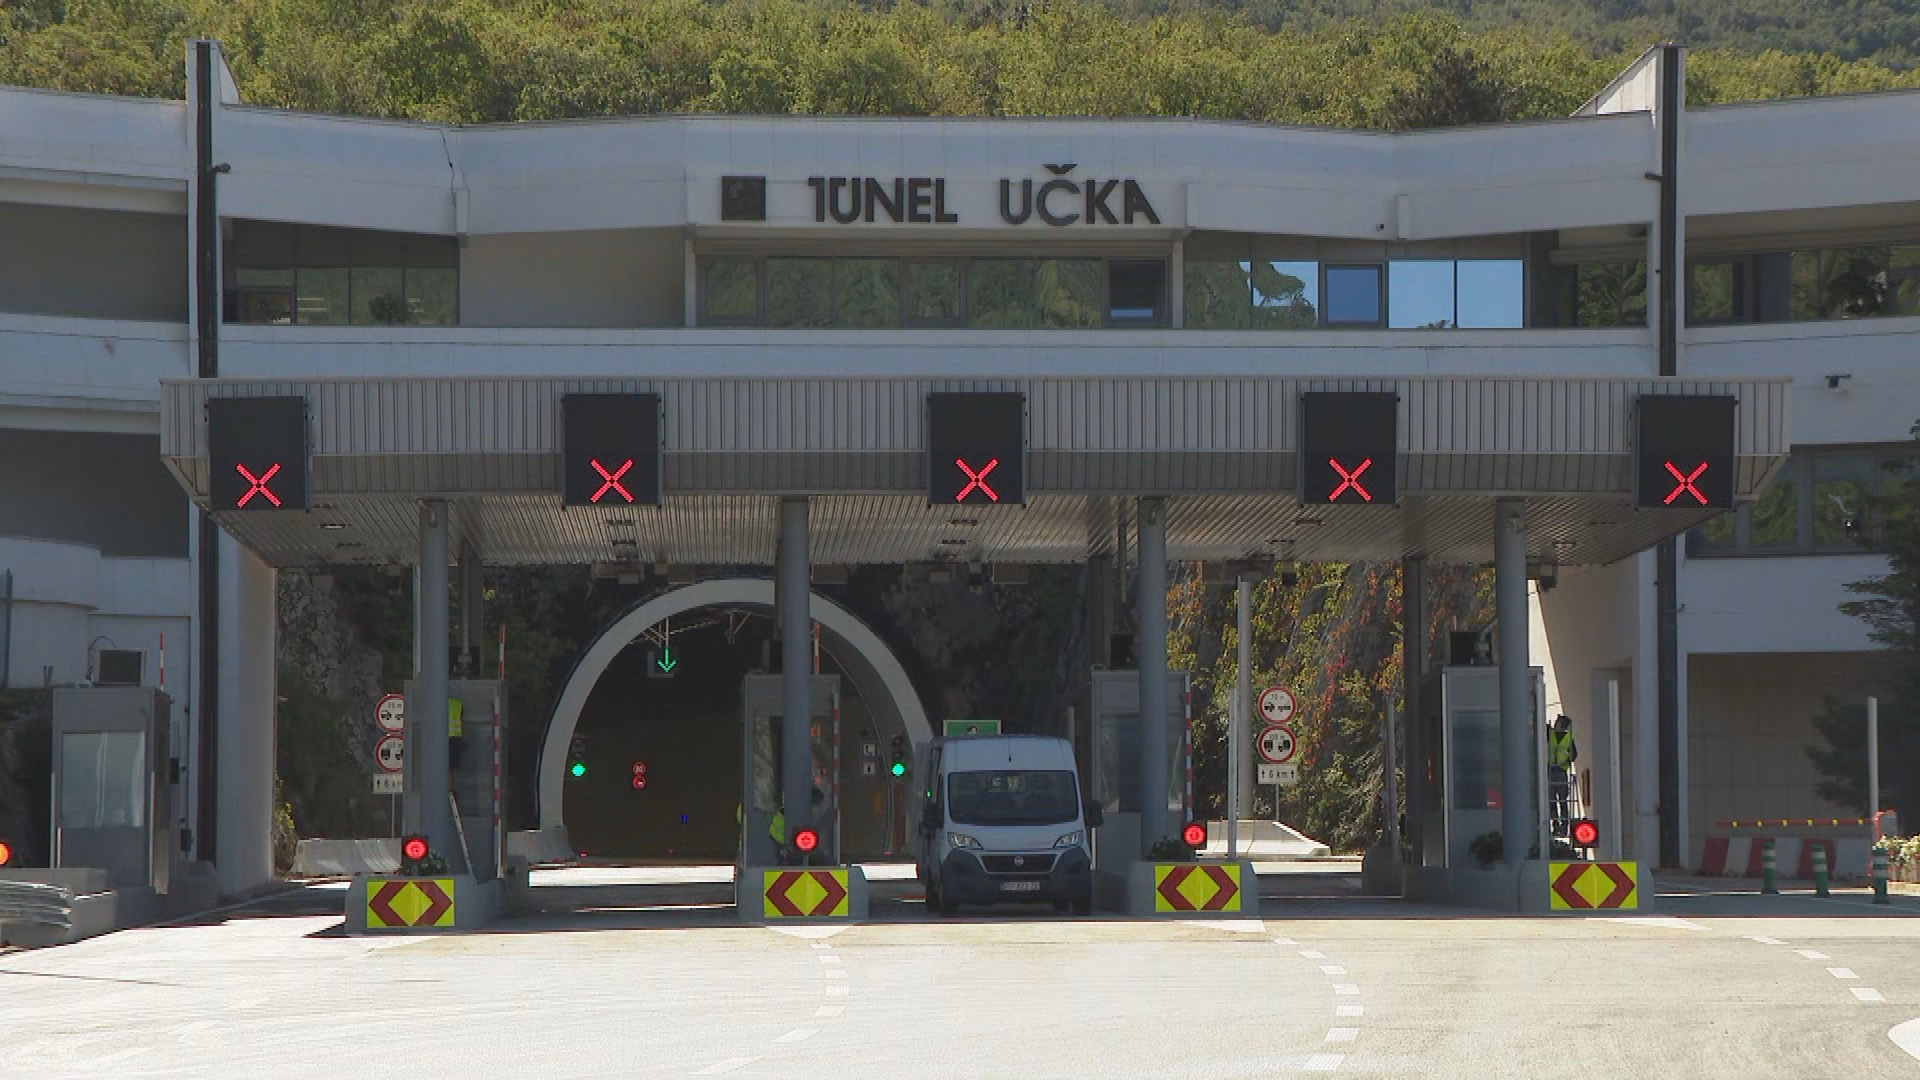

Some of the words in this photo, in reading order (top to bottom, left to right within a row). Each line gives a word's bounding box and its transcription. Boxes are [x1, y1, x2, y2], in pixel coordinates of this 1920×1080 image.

[808, 176, 958, 223] TUNEL
[1000, 163, 1160, 226] UČKA
[1277, 769, 1288, 778] km
